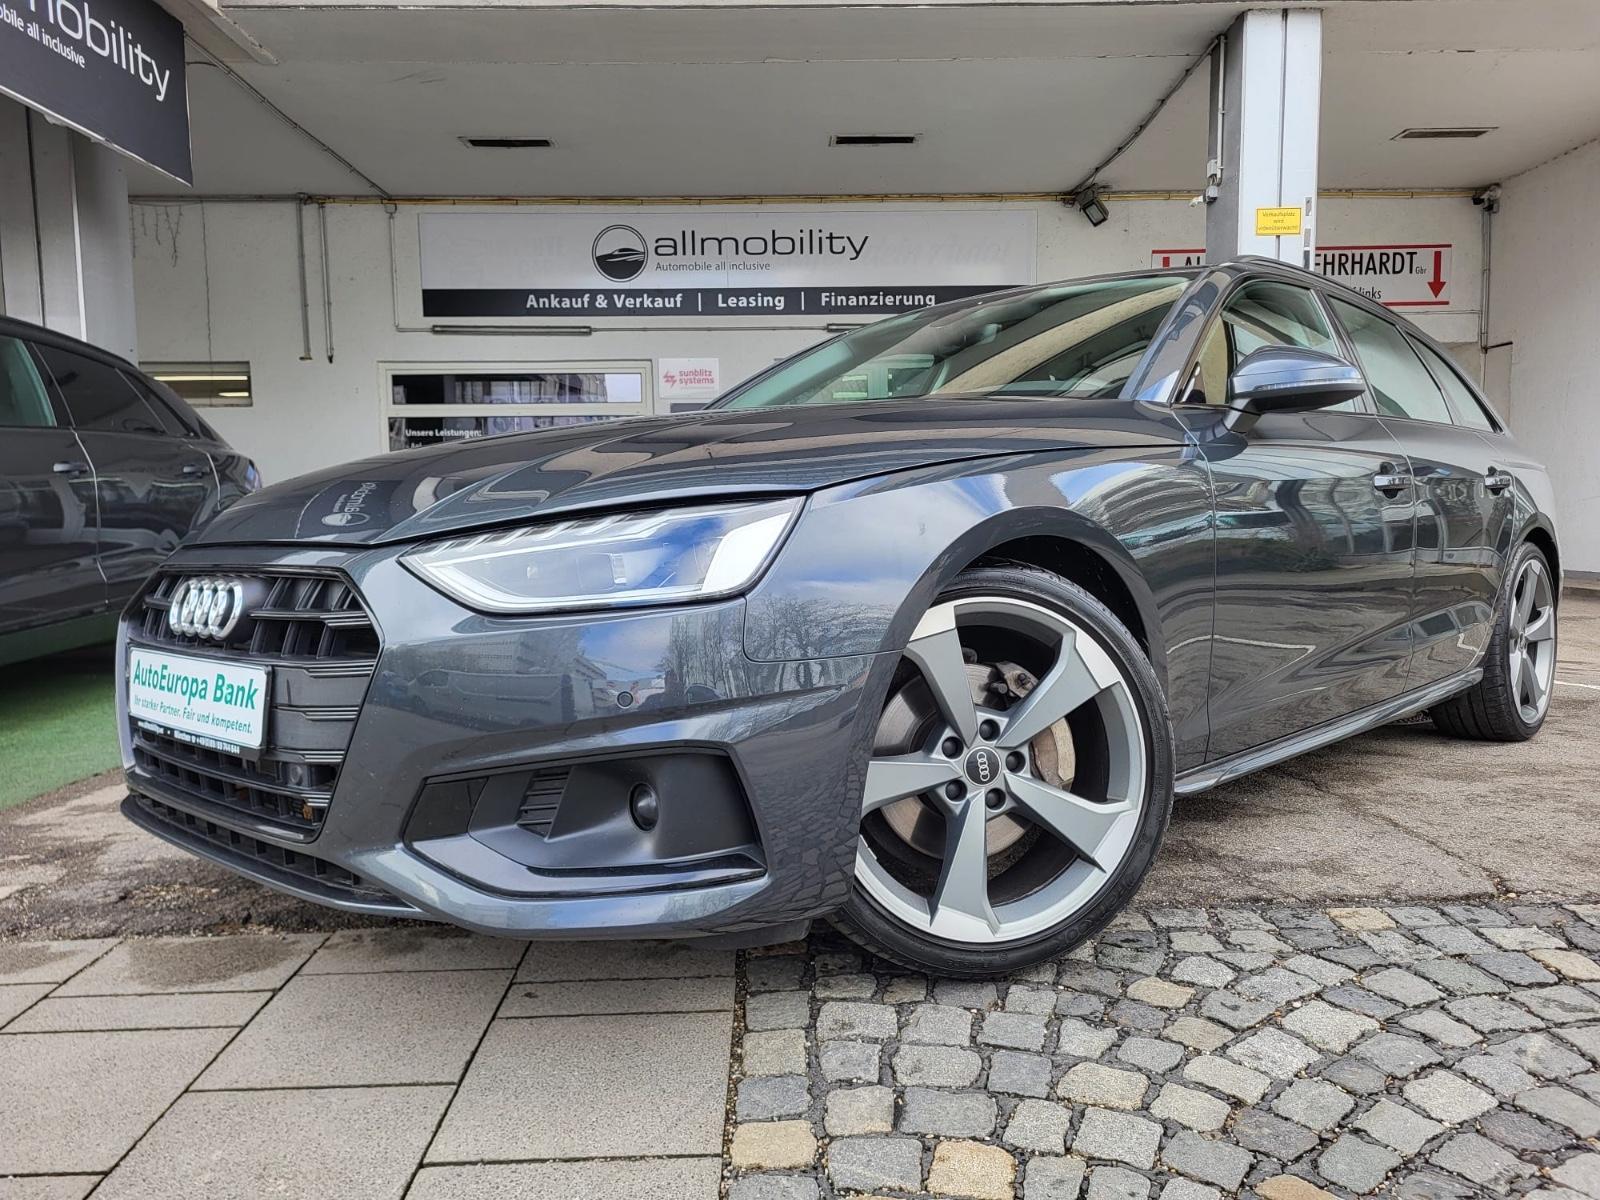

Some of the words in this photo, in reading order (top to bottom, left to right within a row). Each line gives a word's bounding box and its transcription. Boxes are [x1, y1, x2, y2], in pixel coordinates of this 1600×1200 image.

[26, 22, 40, 41] all
[41, 28, 85, 69] inclusive
[654, 229, 869, 261] allmobility
[655, 261, 712, 272] Automobile
[714, 261, 726, 271] all
[729, 261, 771, 271] inclusive
[526, 293, 590, 309] Ankauf
[595, 294, 608, 309] &
[613, 293, 683, 309] Verkauf
[717, 292, 785, 310] Leasing
[821, 291, 936, 308] Finanzierung
[679, 368, 713, 377] sunblitz
[679, 377, 715, 386] systems
[405, 428, 434, 437] Unsere
[435, 428, 482, 439] Leistungen:
[133, 659, 208, 706] AutoEuropa
[213, 673, 259, 710] Bank
[183, 706, 196, 721] Fair
[197, 712, 211, 724] und
[211, 713, 253, 734] kompetent.
